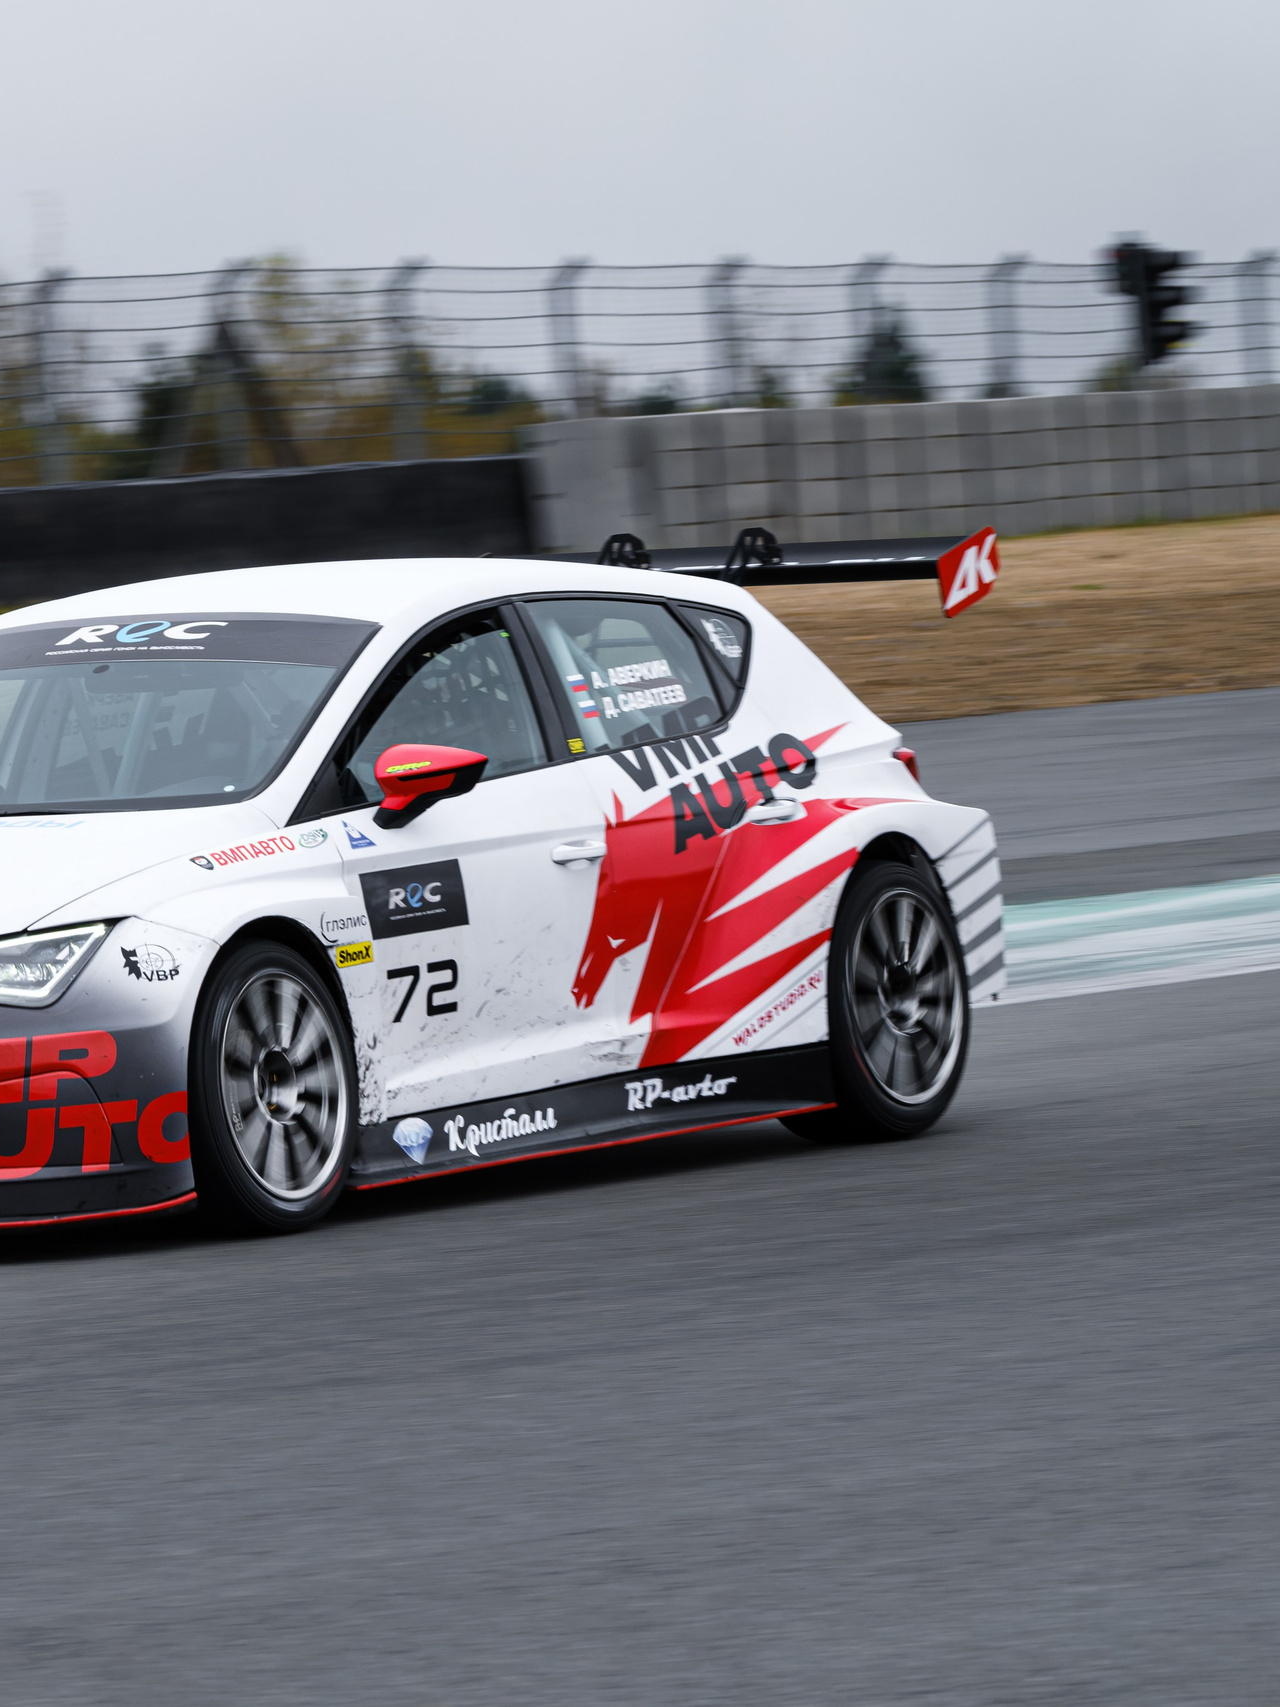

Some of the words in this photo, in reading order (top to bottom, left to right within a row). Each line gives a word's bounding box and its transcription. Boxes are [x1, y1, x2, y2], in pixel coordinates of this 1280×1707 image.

[670, 733, 817, 854] AUTO
[209, 835, 296, 866] ВМПАВТО
[338, 944, 371, 964] ShonX
[142, 968, 180, 982] VBP
[386, 959, 458, 1023] 72
[624, 1073, 738, 1111] RP-avto
